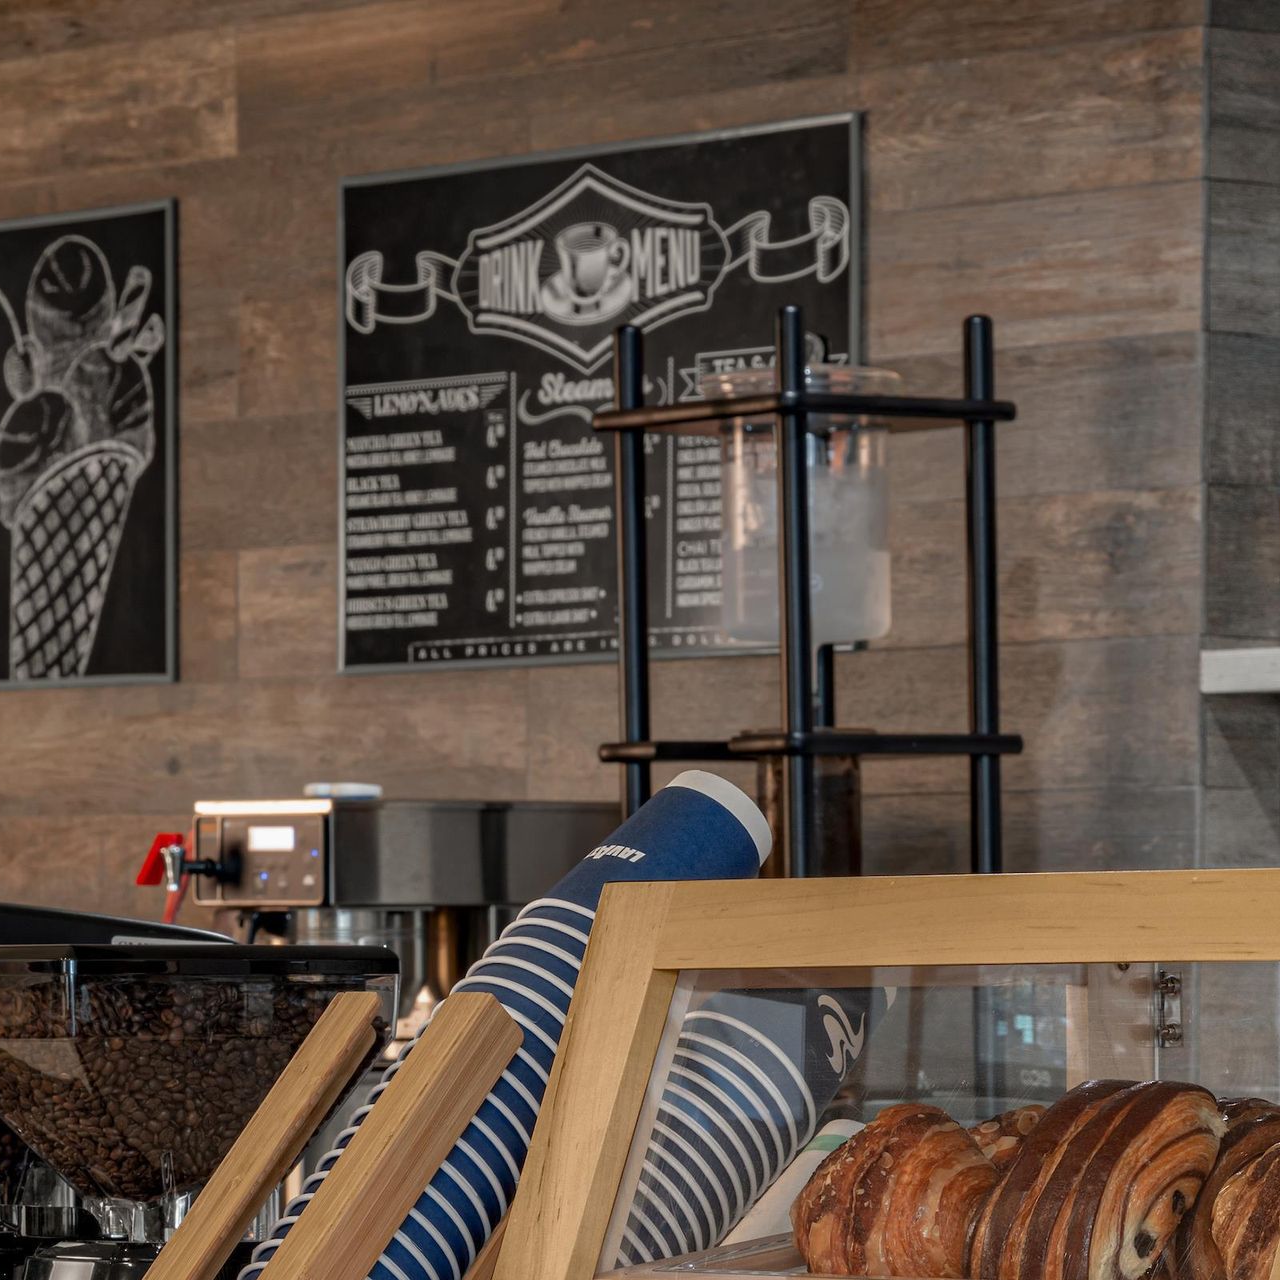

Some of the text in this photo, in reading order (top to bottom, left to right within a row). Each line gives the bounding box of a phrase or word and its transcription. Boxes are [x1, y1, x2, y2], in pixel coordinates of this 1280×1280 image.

[478, 227, 701, 314] DRINK MENU
[373, 385, 479, 417] LEMONADES
[418, 647, 453, 660] ALL
[466, 641, 538, 657] PRICES
[551, 639, 587, 653] ARE
